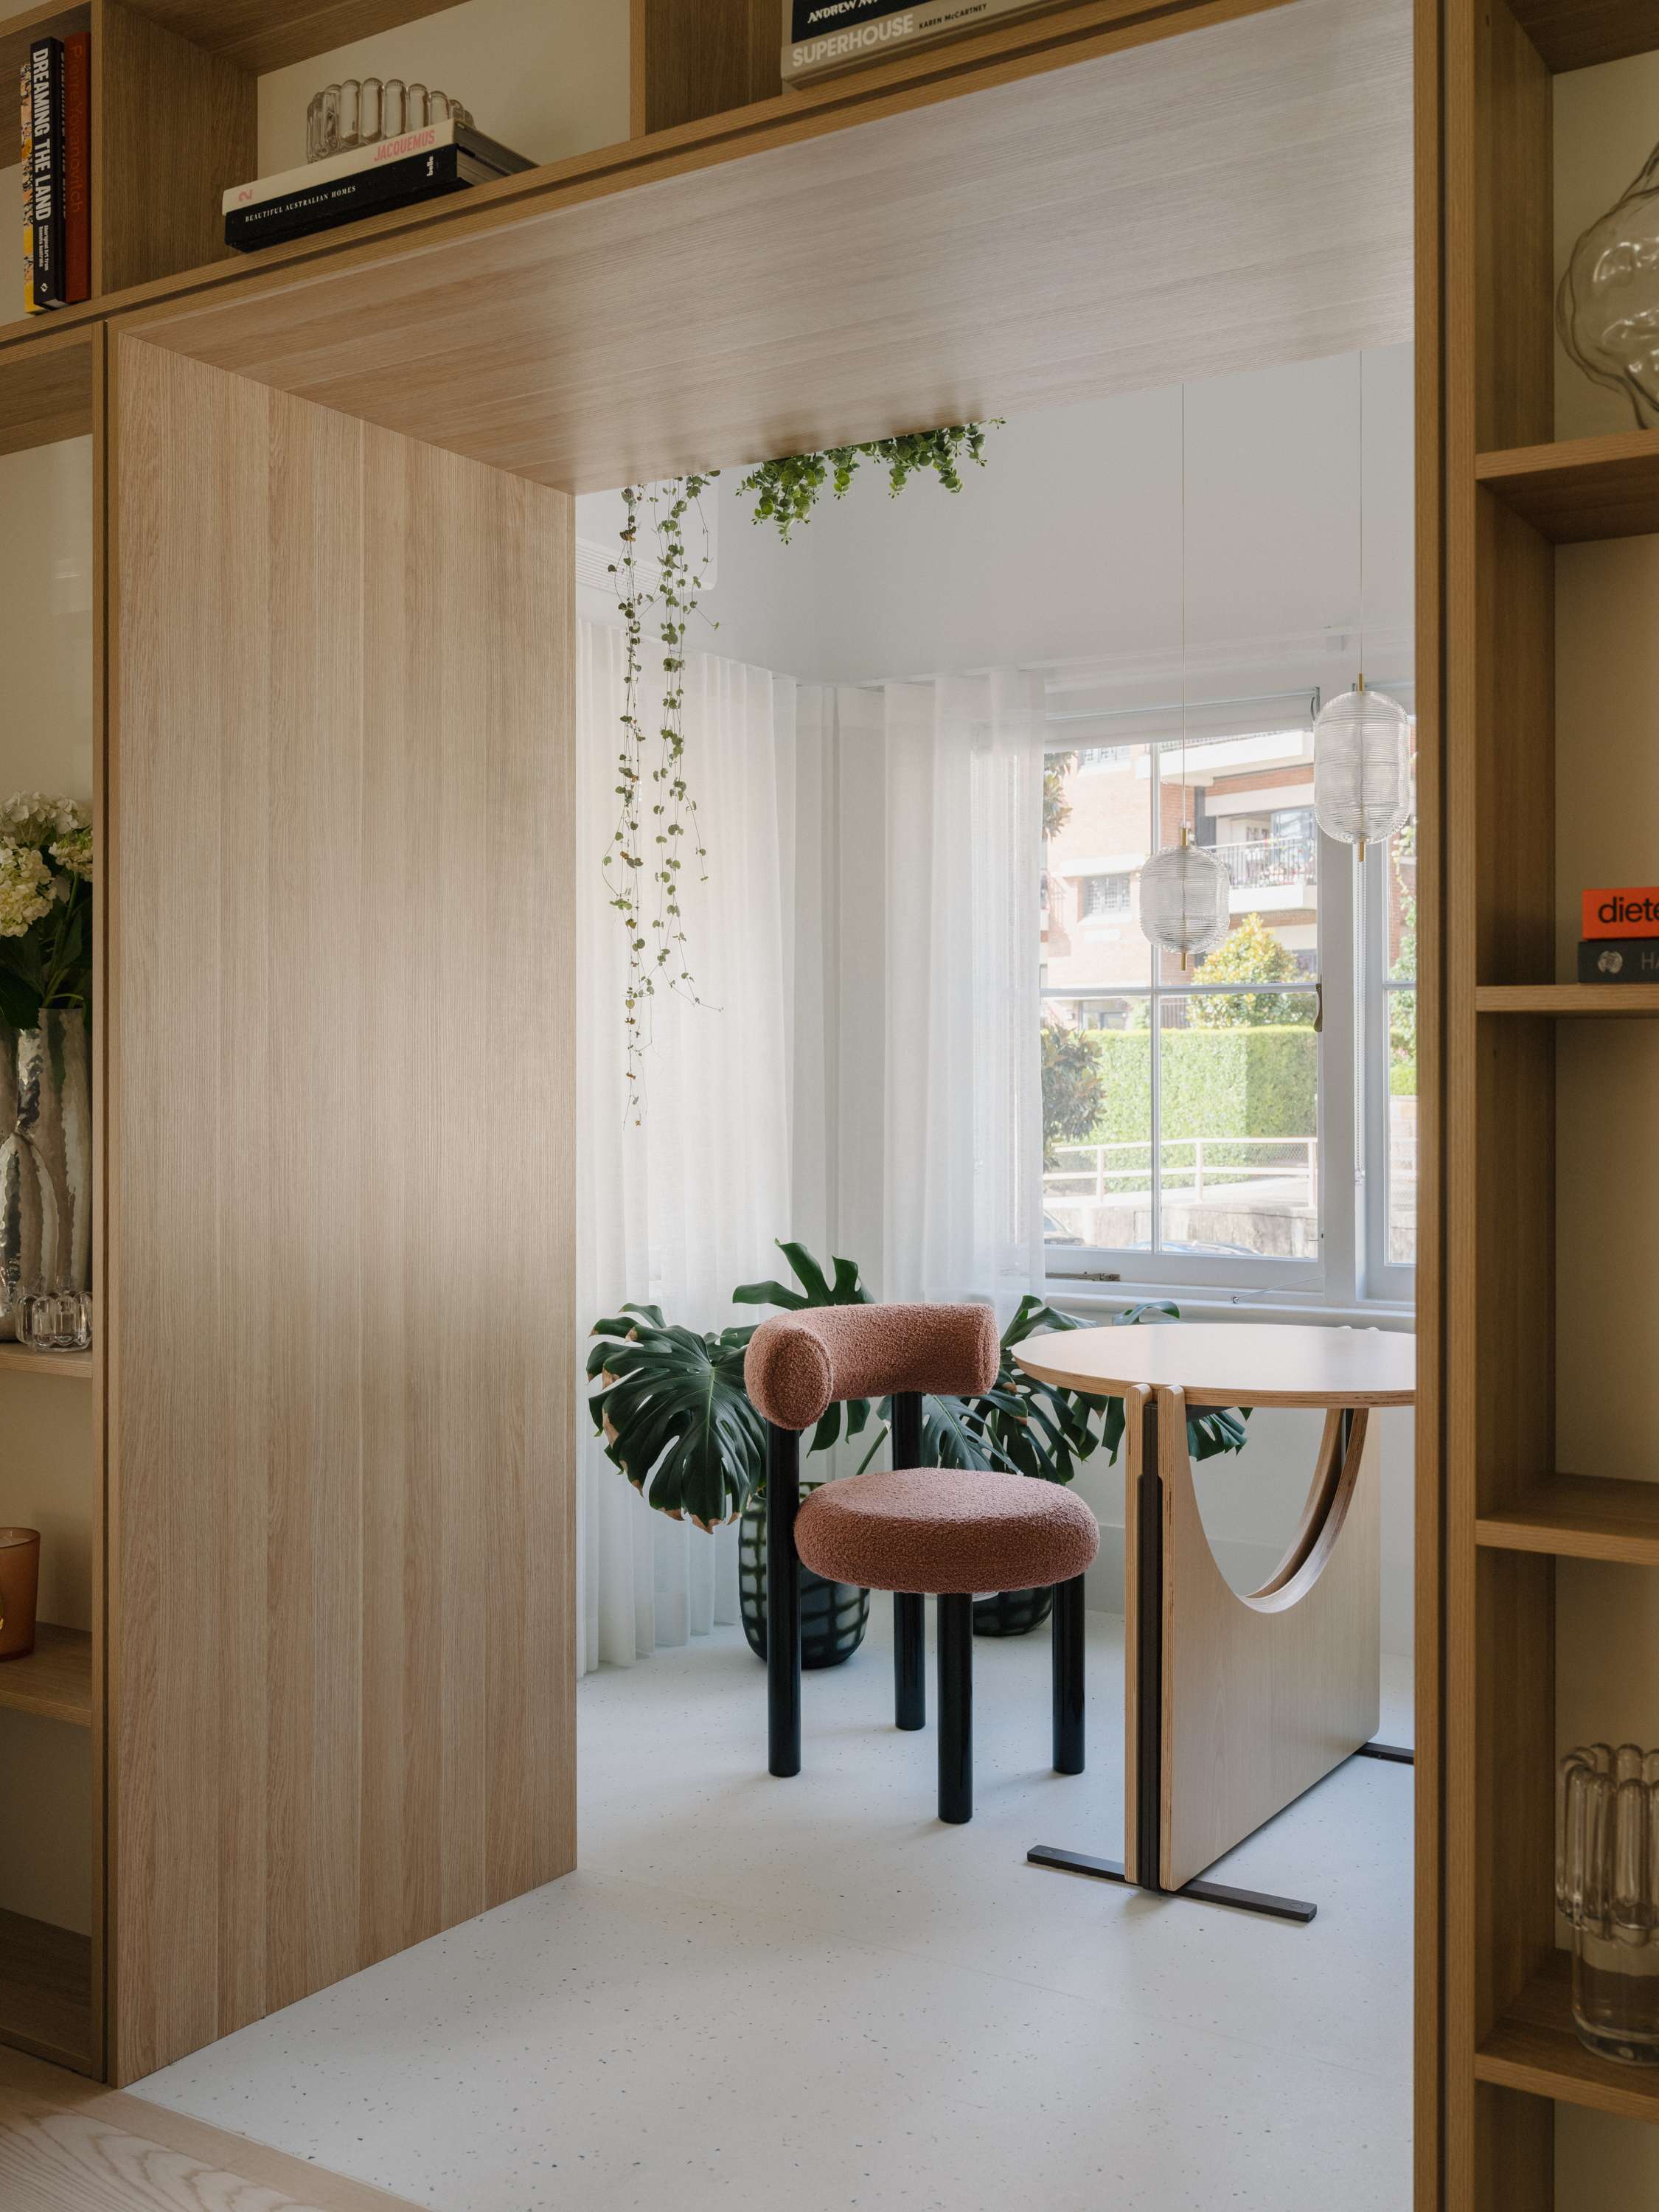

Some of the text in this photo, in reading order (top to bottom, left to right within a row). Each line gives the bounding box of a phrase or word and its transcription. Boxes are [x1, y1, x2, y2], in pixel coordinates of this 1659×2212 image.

[807, 0, 857, 24] ANDREW
[792, 3, 987, 67] SUPERHOUSE KAREN McCARTNEY
[33, 47, 52, 221] DREAMING THE LAND
[373, 129, 436, 162] JACQUEMUS
[245, 185, 357, 223] BEAUTIFUL AUSTRALIAN HOMES
